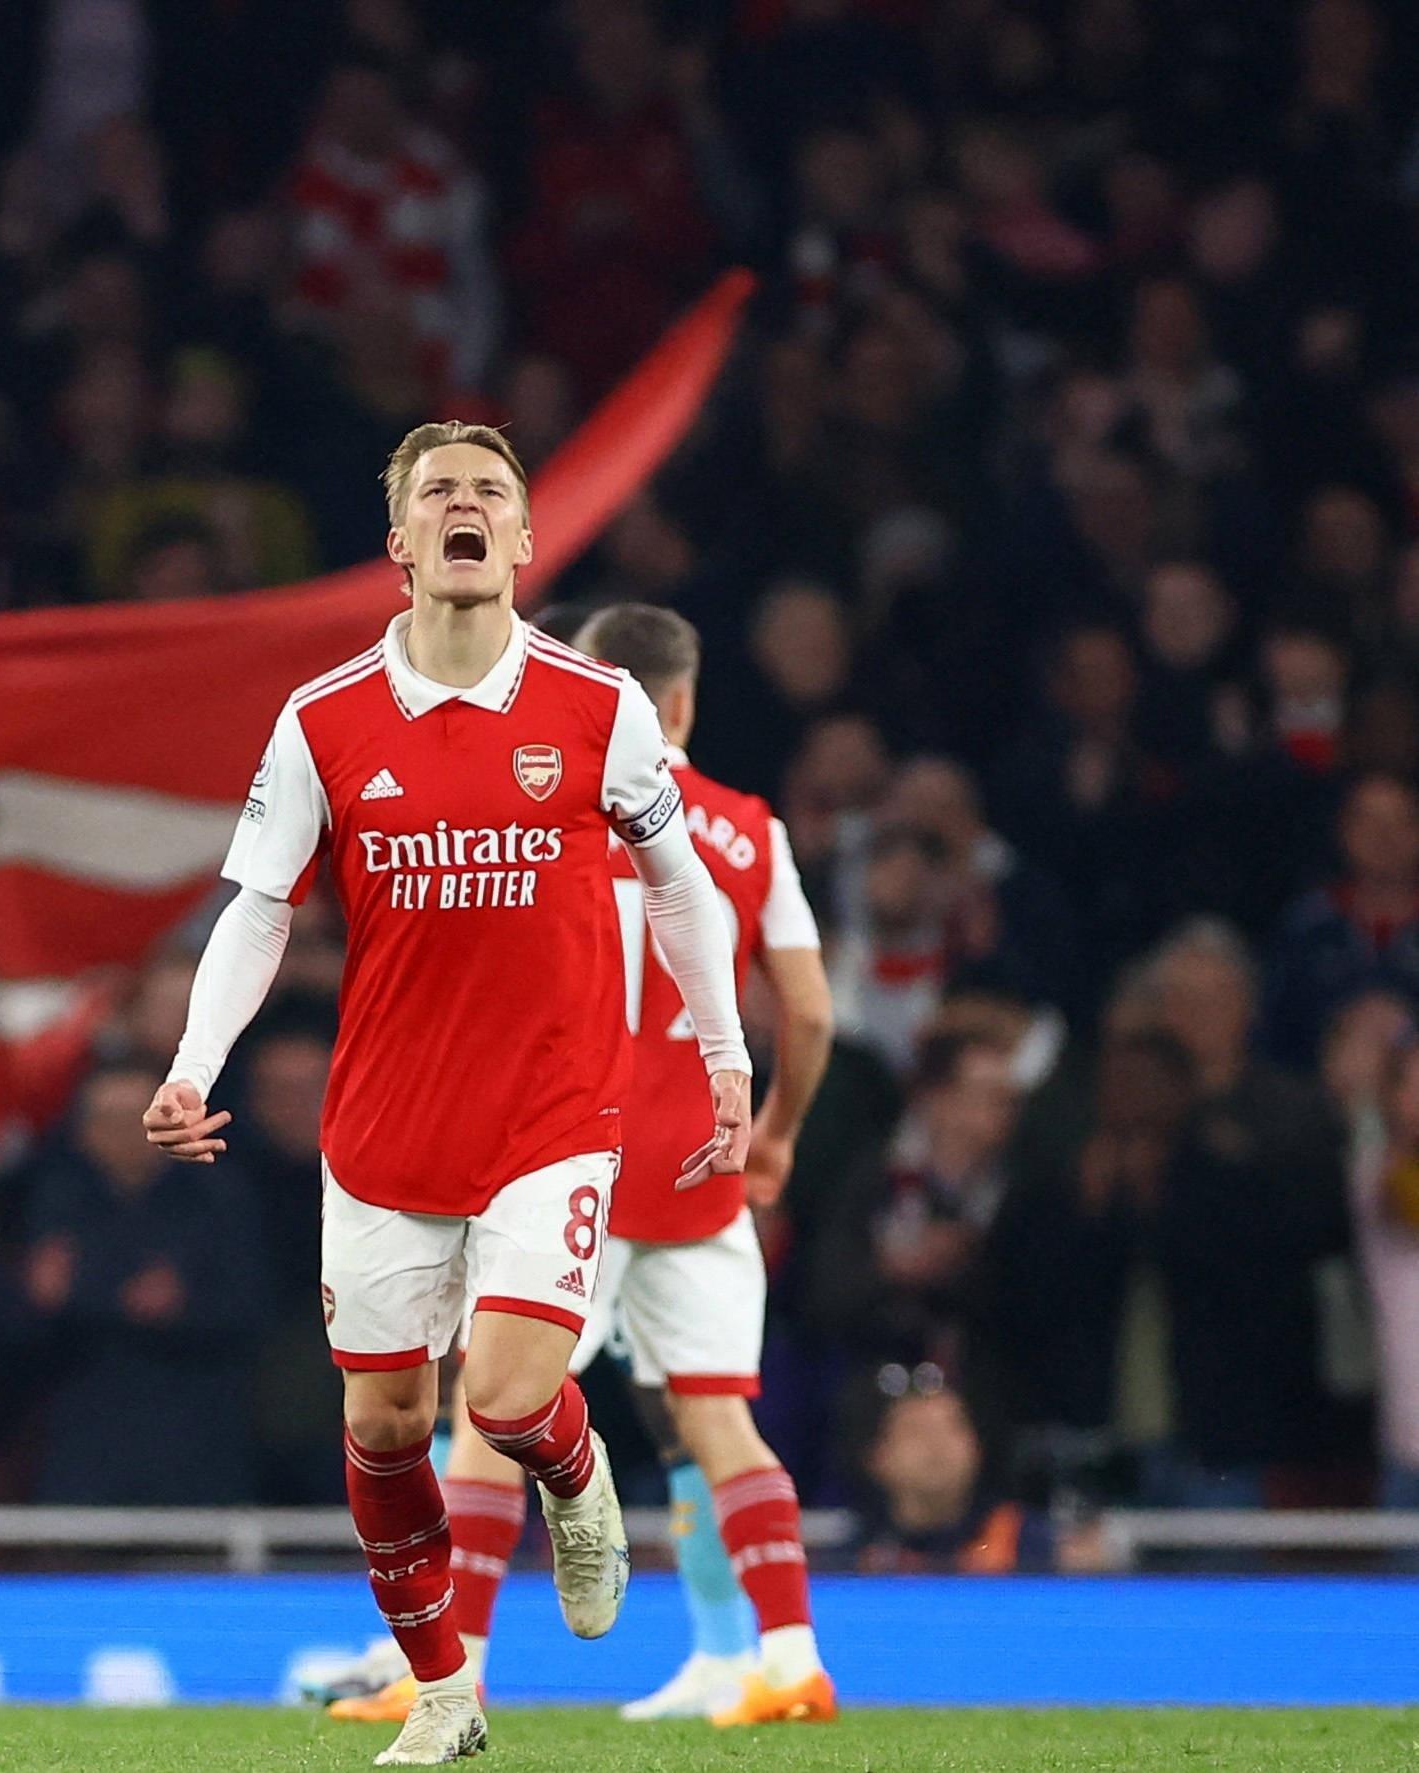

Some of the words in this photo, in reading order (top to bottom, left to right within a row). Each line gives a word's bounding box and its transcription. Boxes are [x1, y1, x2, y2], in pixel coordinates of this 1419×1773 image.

[360, 785, 404, 801] adidas
[358, 820, 563, 873] Emirates
[391, 873, 431, 910] FLY
[439, 870, 537, 910] BETTER
[564, 1185, 599, 1261] 8
[555, 1280, 586, 1298] adida
